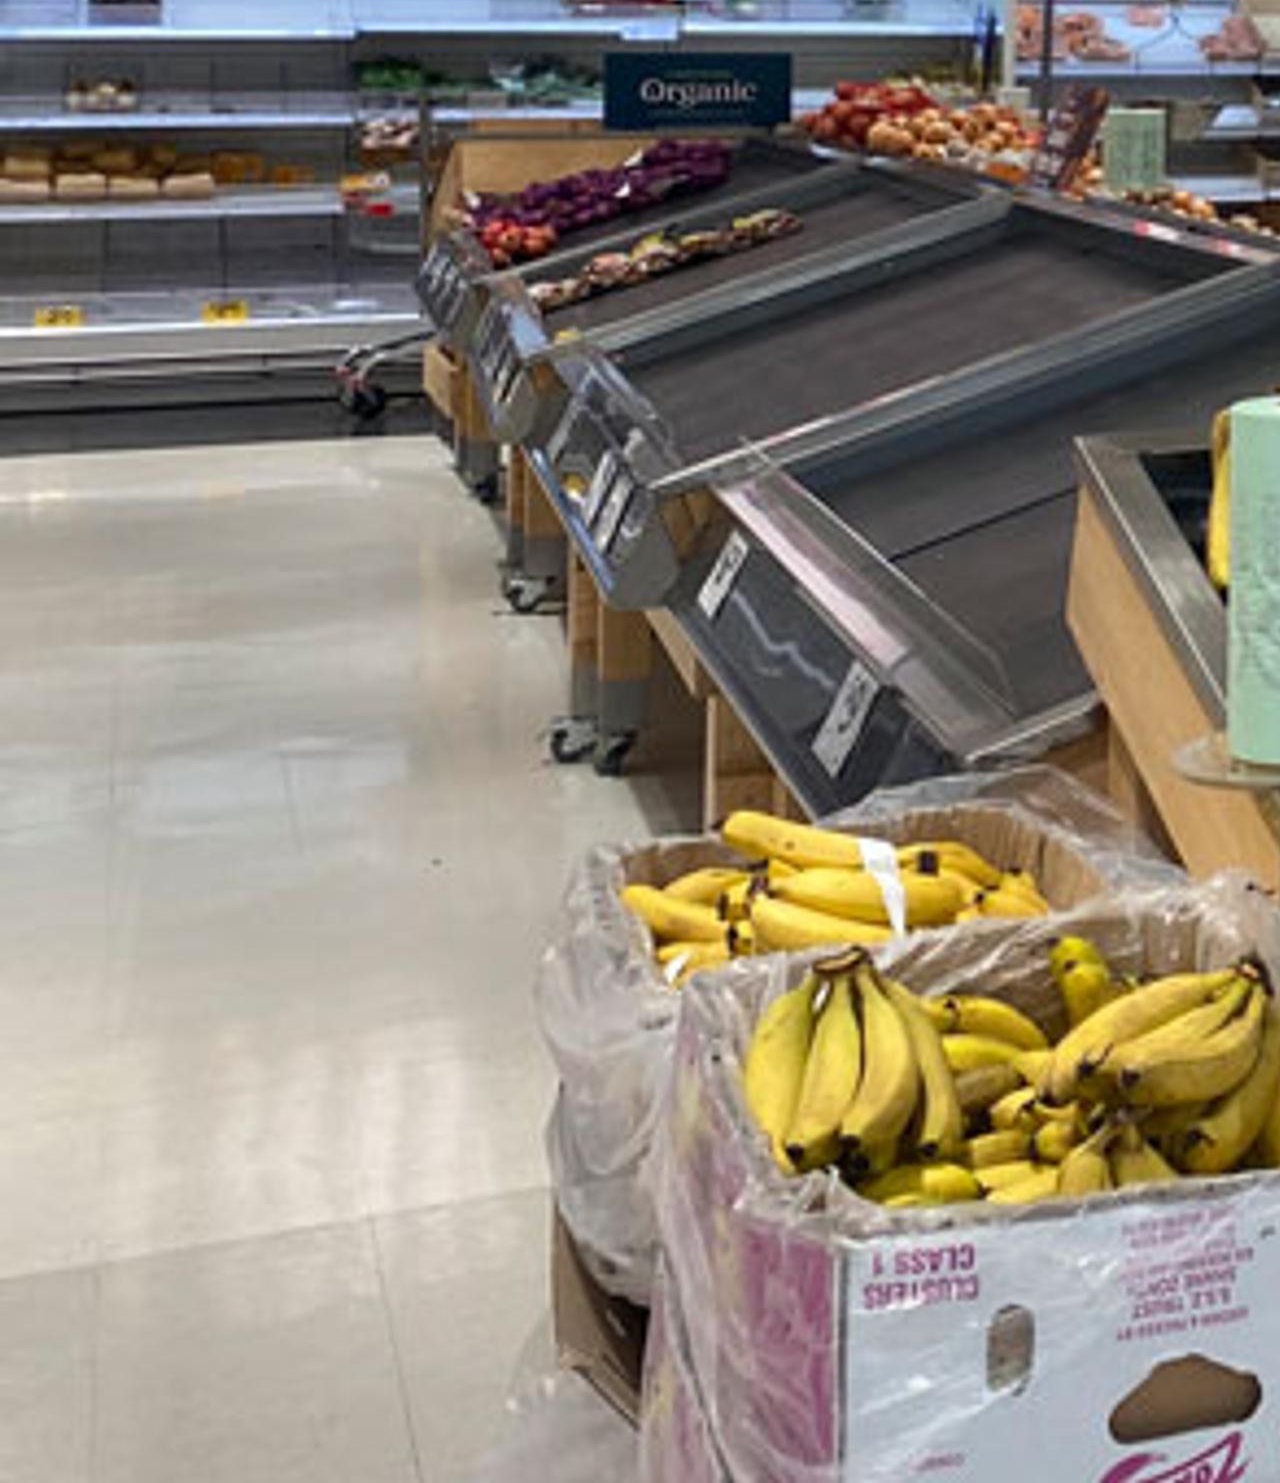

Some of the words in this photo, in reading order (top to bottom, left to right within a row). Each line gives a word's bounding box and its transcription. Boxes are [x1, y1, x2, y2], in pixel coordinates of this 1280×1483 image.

[639, 78, 758, 107] Organic
[871, 1251, 883, 1276] 1
[893, 1242, 976, 1276] CLASS
[862, 1273, 980, 1309] CLUSTERS
